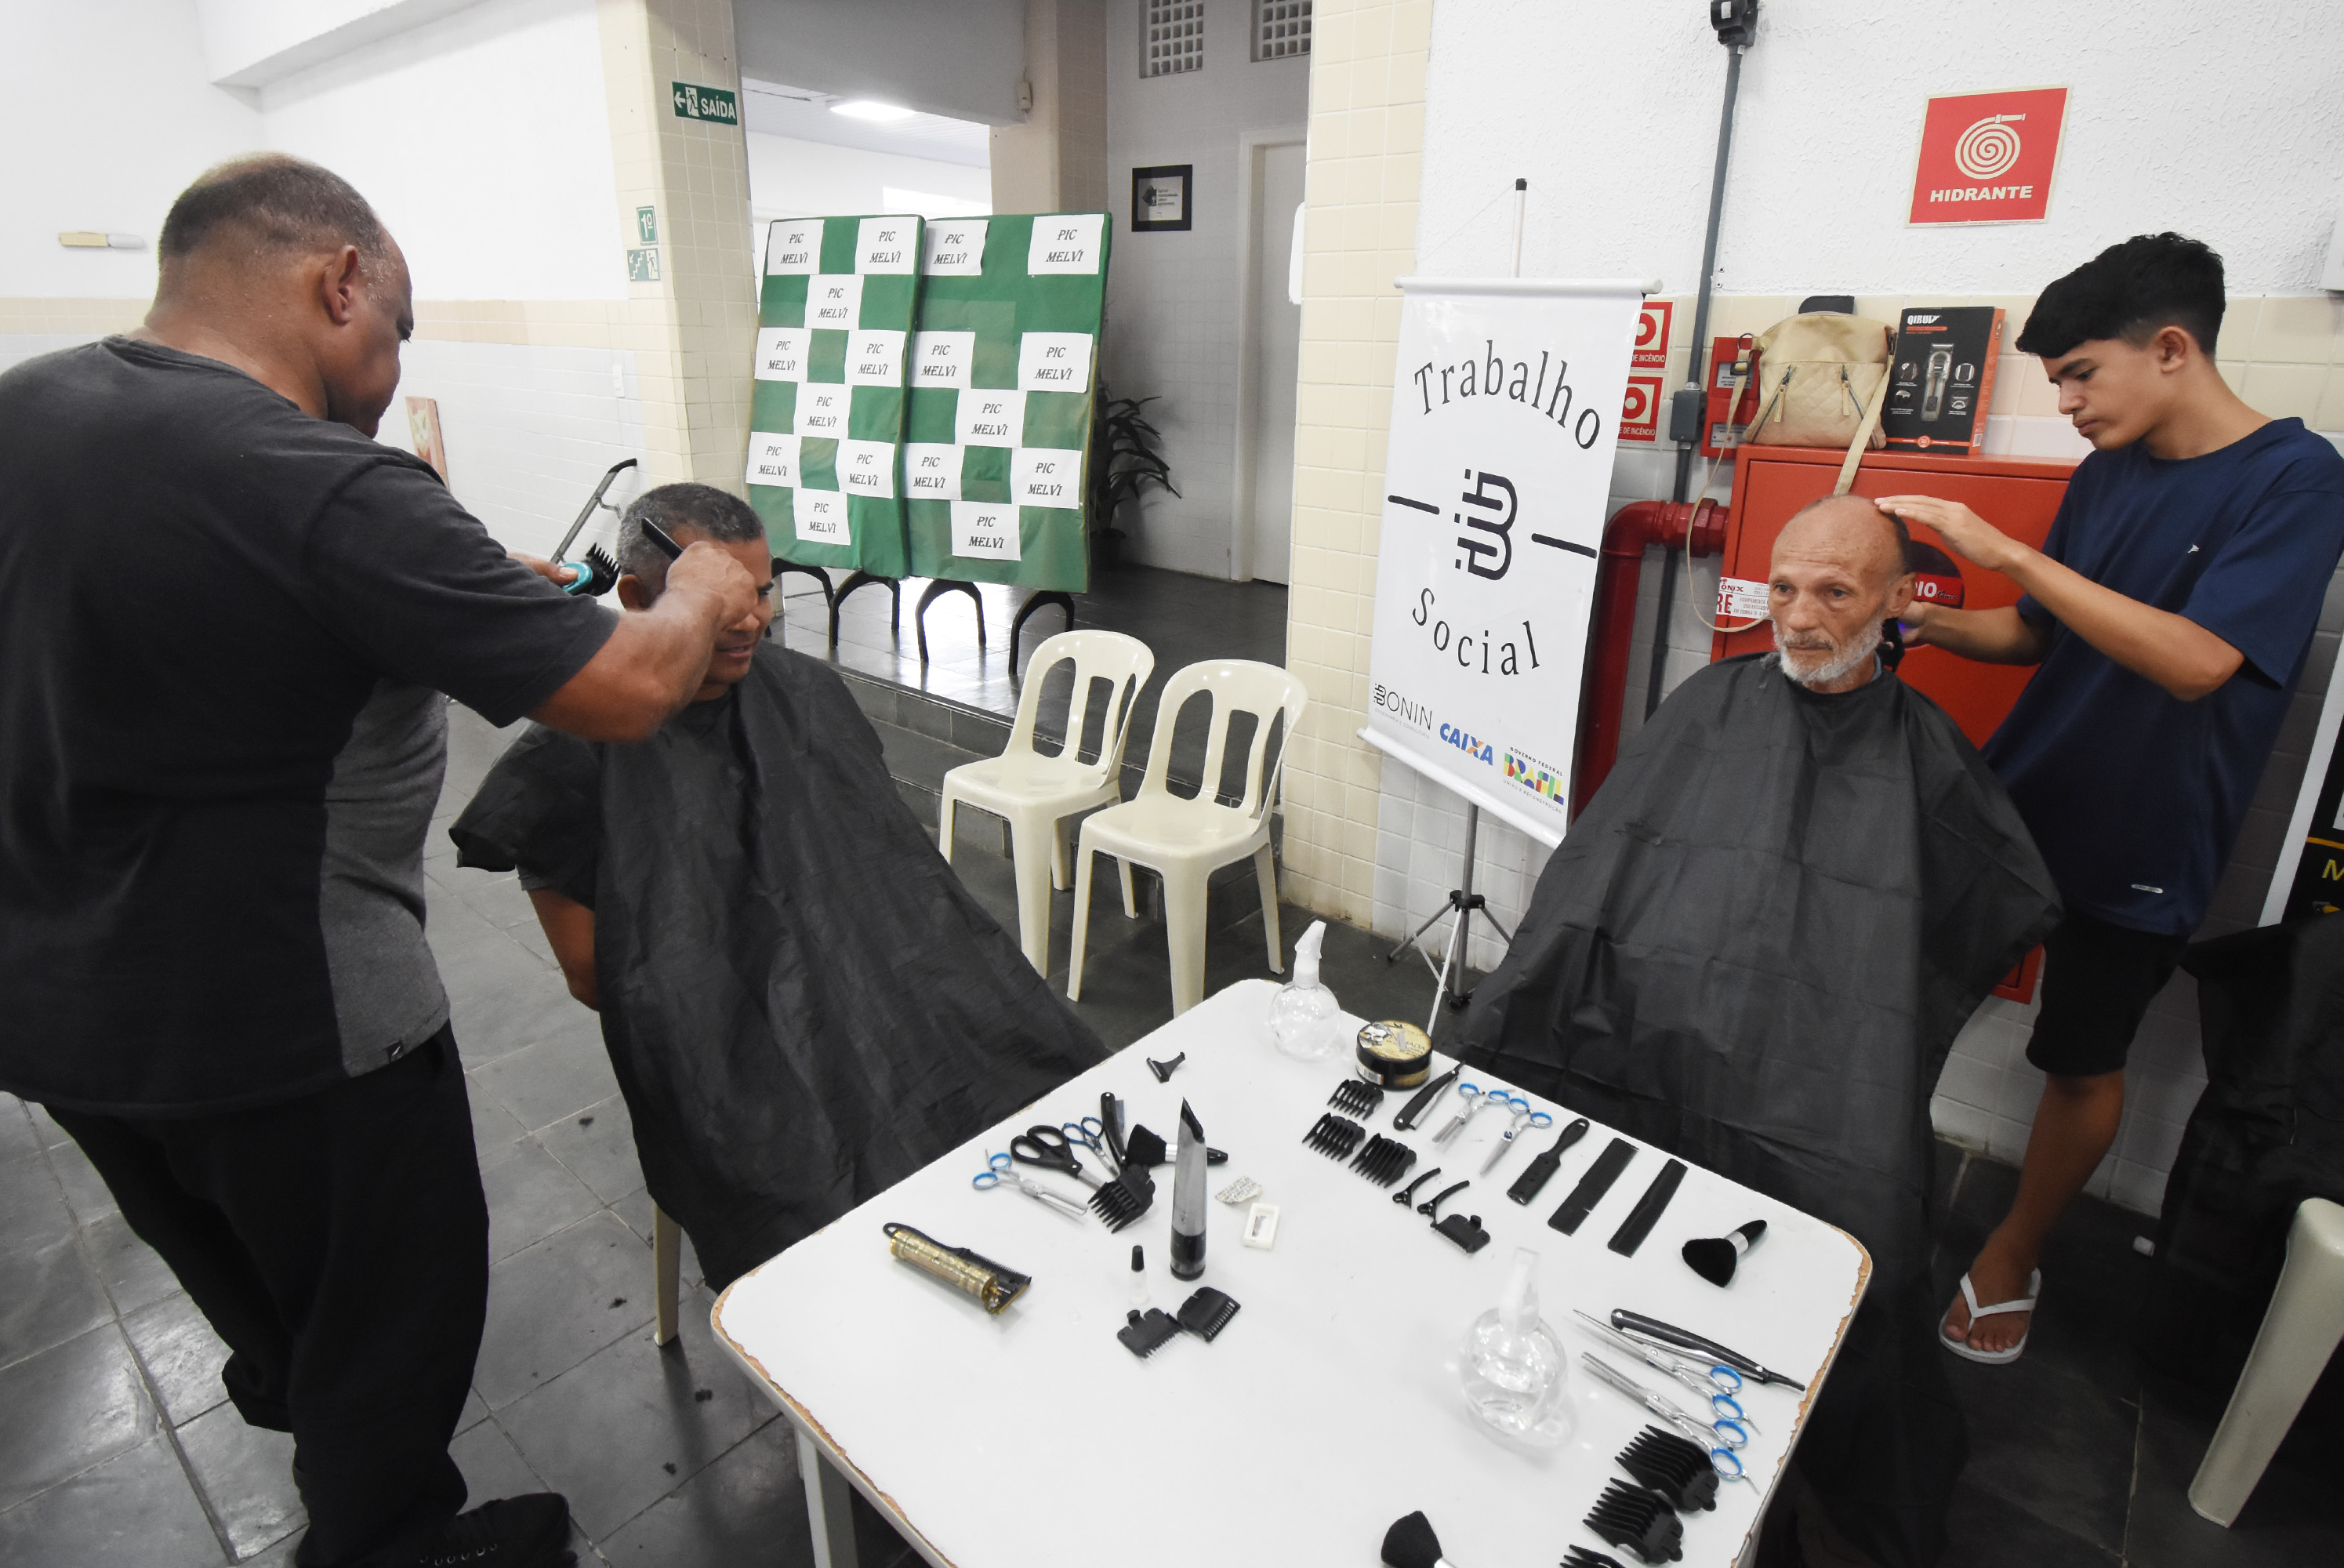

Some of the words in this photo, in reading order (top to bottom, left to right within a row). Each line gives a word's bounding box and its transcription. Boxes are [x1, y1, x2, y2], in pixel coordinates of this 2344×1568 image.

[701, 96, 735, 119] SAÍDA
[1929, 185, 2034, 202] HIDRANTE
[789, 233, 804, 244] PIC
[878, 230, 896, 242] PIC
[944, 234, 964, 245] PIC
[1057, 229, 1078, 241] PIC
[779, 252, 808, 264] MELVI
[870, 251, 902, 263] MELVI
[932, 252, 968, 265] MELVI
[1045, 249, 1084, 263] MELVI
[827, 288, 844, 299] PIC
[818, 307, 848, 318] MELVI
[775, 340, 791, 350] PIC
[866, 343, 884, 354] PIC
[931, 344, 951, 356] PIC
[1046, 347, 1066, 358] PIC
[1639, 353, 1665, 362] INCÊNDIO
[767, 359, 796, 371] MELVI
[858, 363, 889, 376] MELVI
[920, 365, 957, 377] MELVI
[1033, 367, 1073, 380] MELVI
[1413, 339, 1601, 449] Trabalho
[816, 396, 833, 407] PIC
[982, 403, 1003, 414] PIC
[807, 416, 837, 427] MELVI
[970, 423, 1008, 436] MELVI
[1631, 426, 1655, 436] INCÊNDIO
[767, 445, 782, 456] PIC
[856, 454, 873, 465] PIC
[920, 456, 941, 467] PIC
[759, 464, 787, 477] MELVI
[1035, 463, 1056, 474] PIC
[847, 473, 879, 486] MELVI
[912, 477, 946, 488] MELVI
[1026, 484, 1063, 496] MELVI
[814, 503, 829, 514] PIC
[807, 521, 836, 534] MELVI
[976, 516, 996, 528] PIC
[967, 535, 1005, 549] MELVI
[1412, 587, 1540, 676] Social
[1373, 683, 1432, 731] BONIN
[1440, 723, 1493, 766] CAIXA
[1510, 746, 1537, 763] GOVERNO
[1538, 760, 1563, 777] FEDERAL
[1503, 753, 1565, 806] BRASIL
